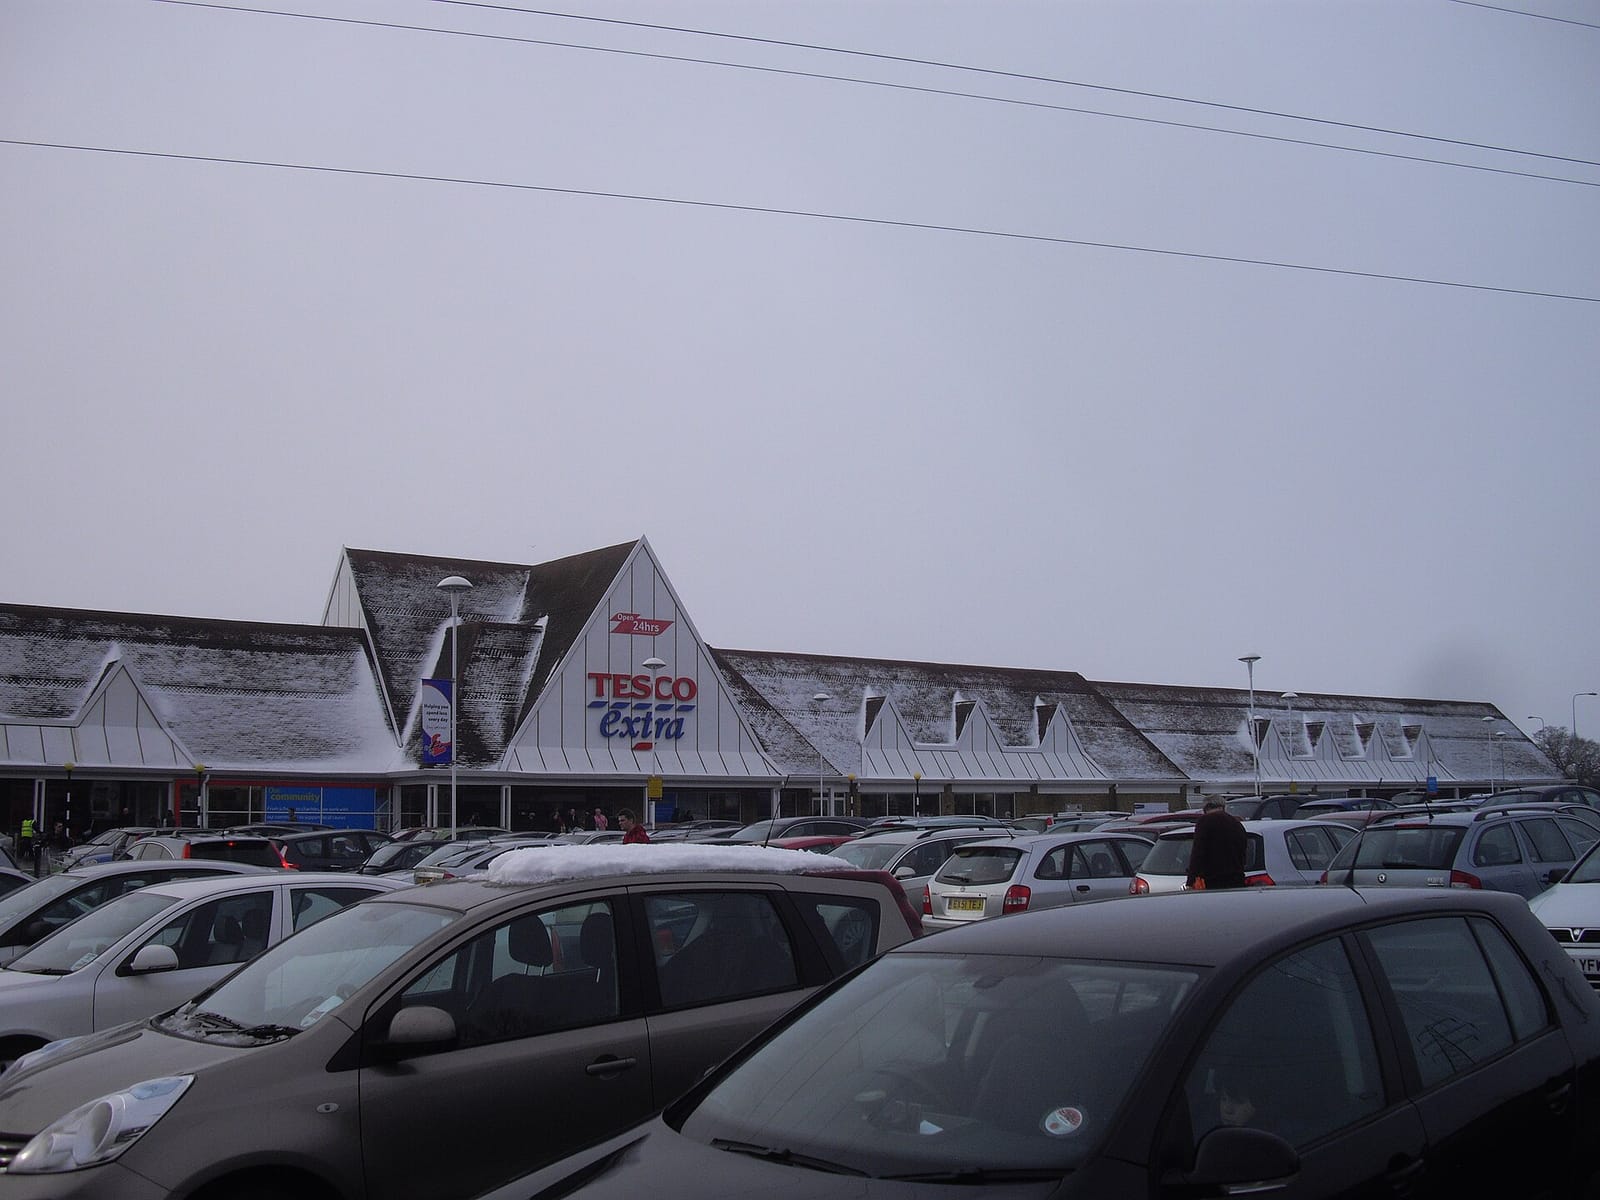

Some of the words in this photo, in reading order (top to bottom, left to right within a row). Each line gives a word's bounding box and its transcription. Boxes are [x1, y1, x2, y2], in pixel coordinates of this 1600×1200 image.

[617, 613, 634, 622] Open
[632, 620, 660, 633] 24hrs
[588, 673, 697, 701] TESCO
[599, 710, 685, 740] extra
[270, 792, 320, 803] community
